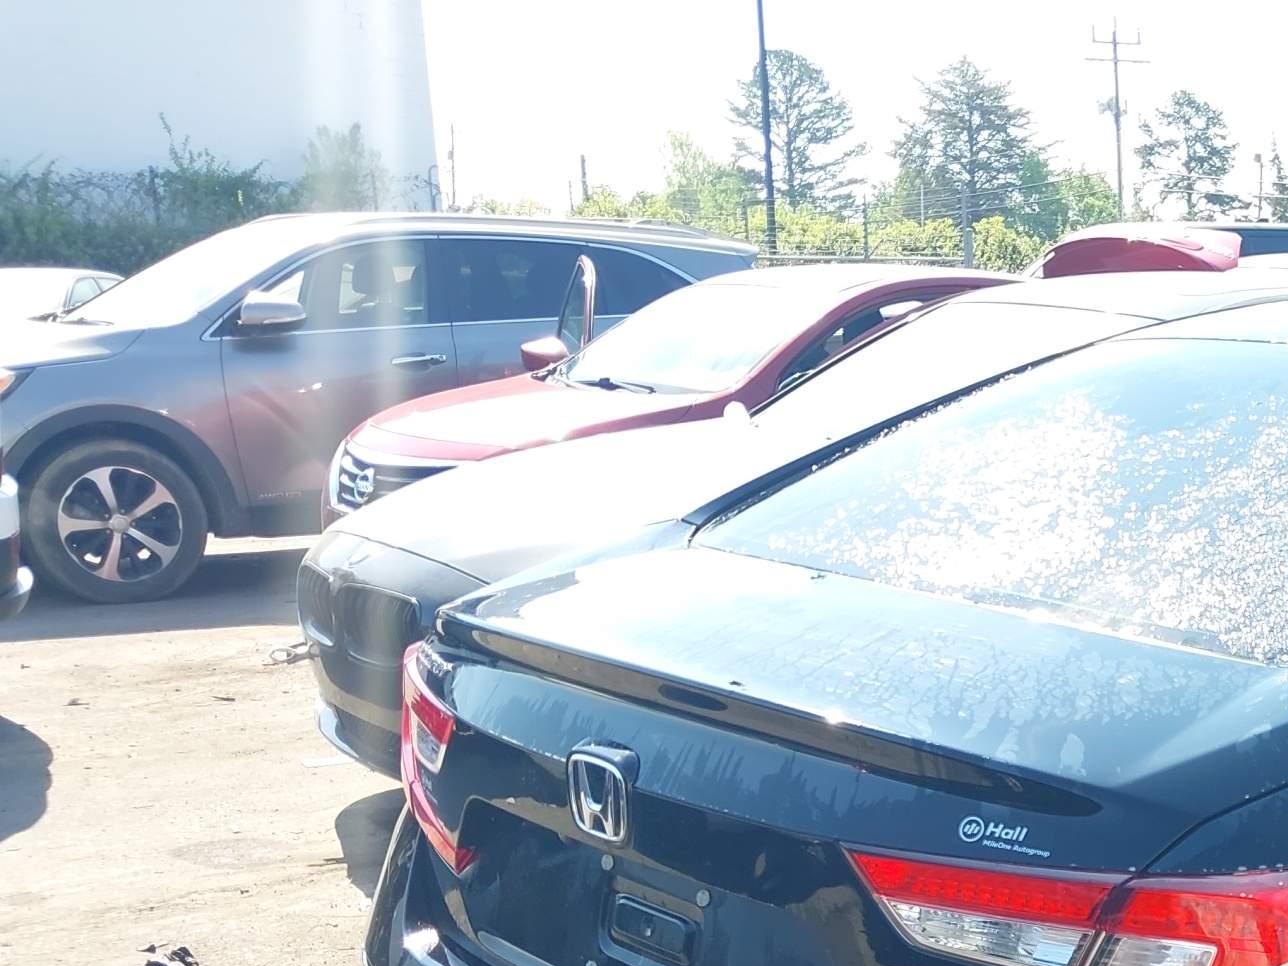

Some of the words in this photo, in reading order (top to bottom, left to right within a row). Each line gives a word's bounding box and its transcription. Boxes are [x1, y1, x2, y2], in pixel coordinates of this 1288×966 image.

[985, 822, 1028, 841] Hall
[982, 840, 1012, 851] MileOne
[1012, 845, 1051, 858] Autogroup
